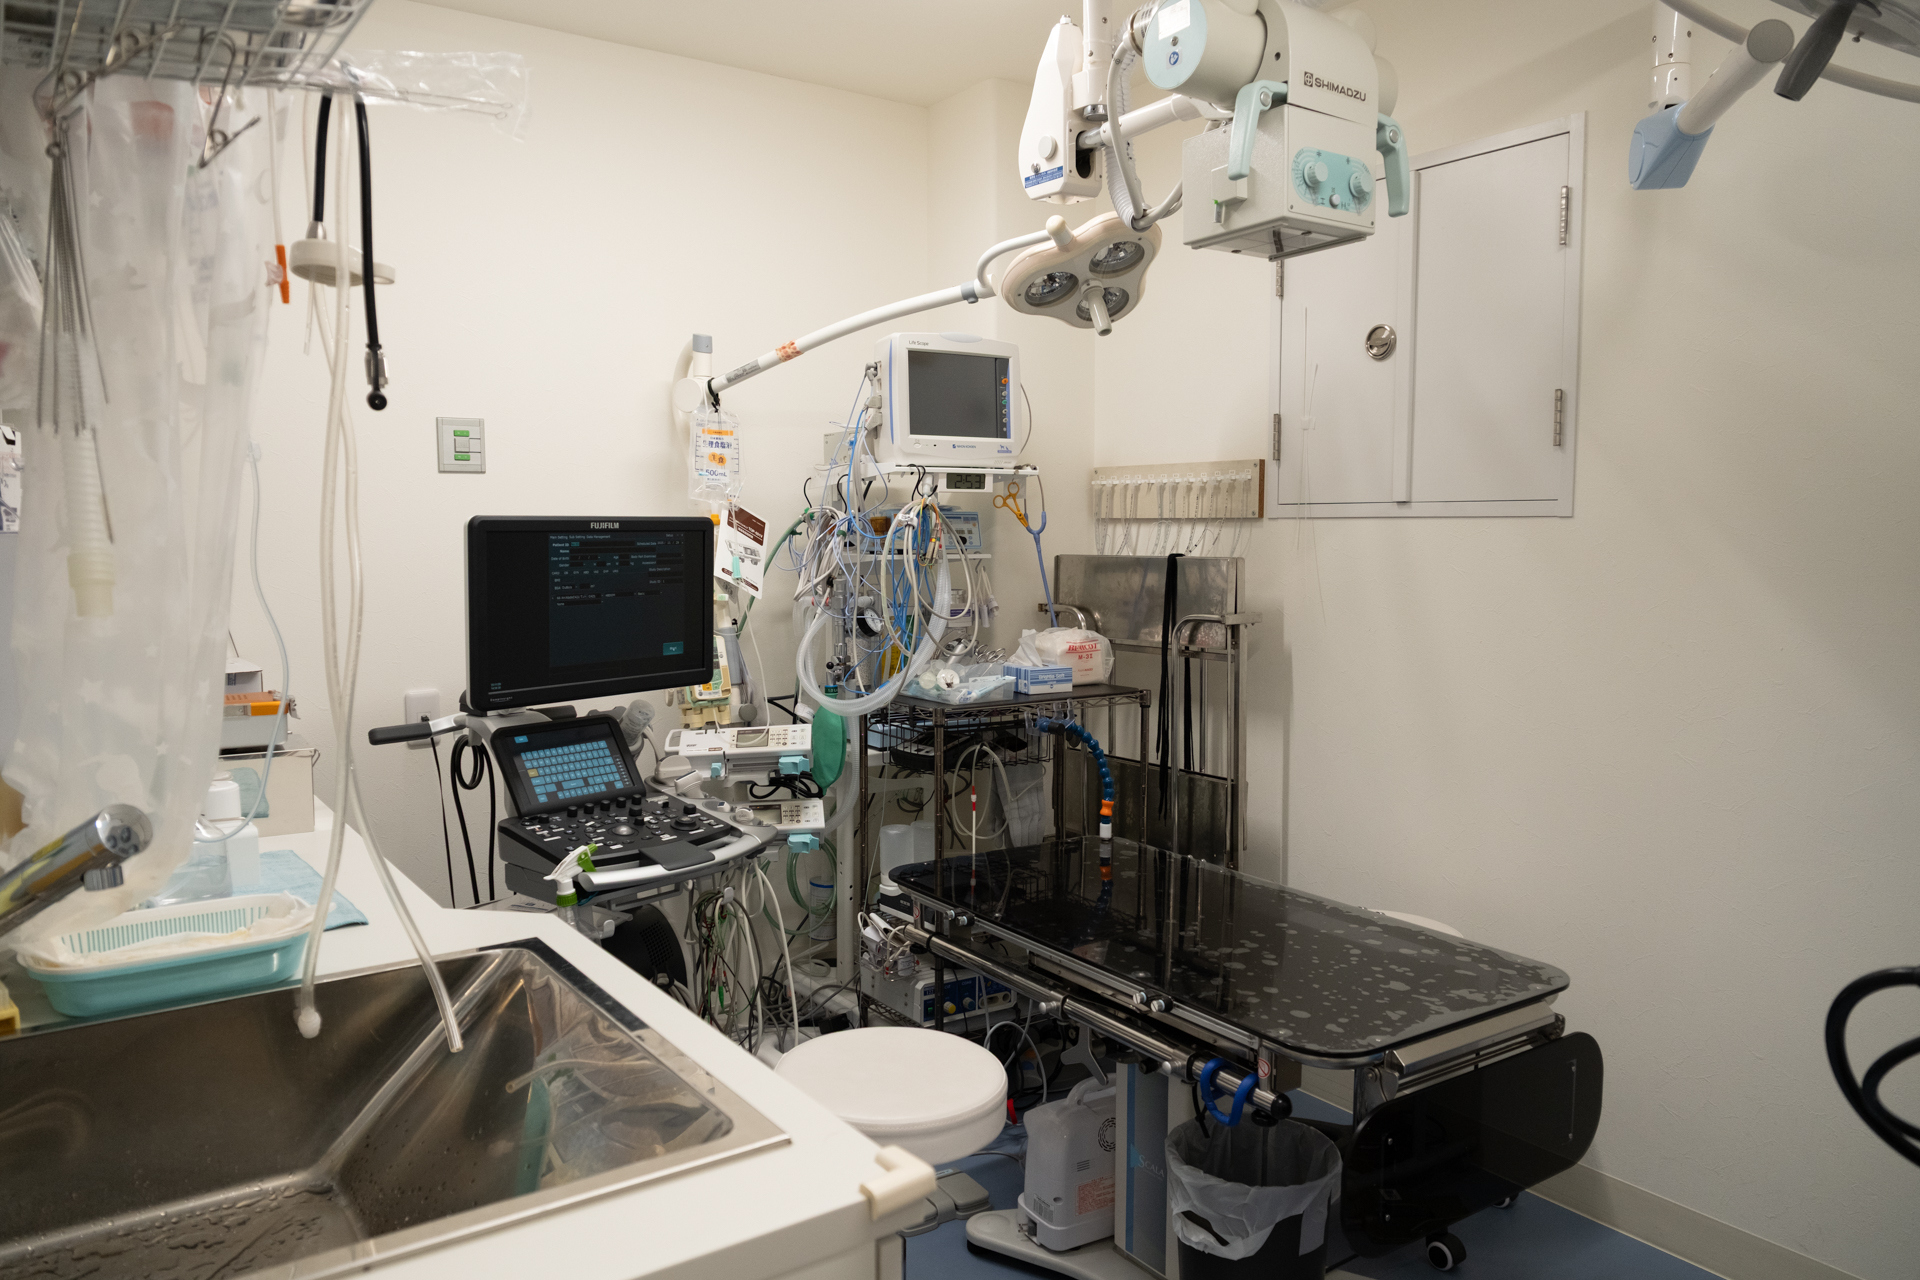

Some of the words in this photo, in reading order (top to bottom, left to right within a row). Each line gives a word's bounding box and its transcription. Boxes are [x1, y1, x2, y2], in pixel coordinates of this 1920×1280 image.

[1314, 77, 1367, 102] SHIMADZU
[954, 474, 981, 489] 2:53
[1138, 1154, 1164, 1178] SCALA
